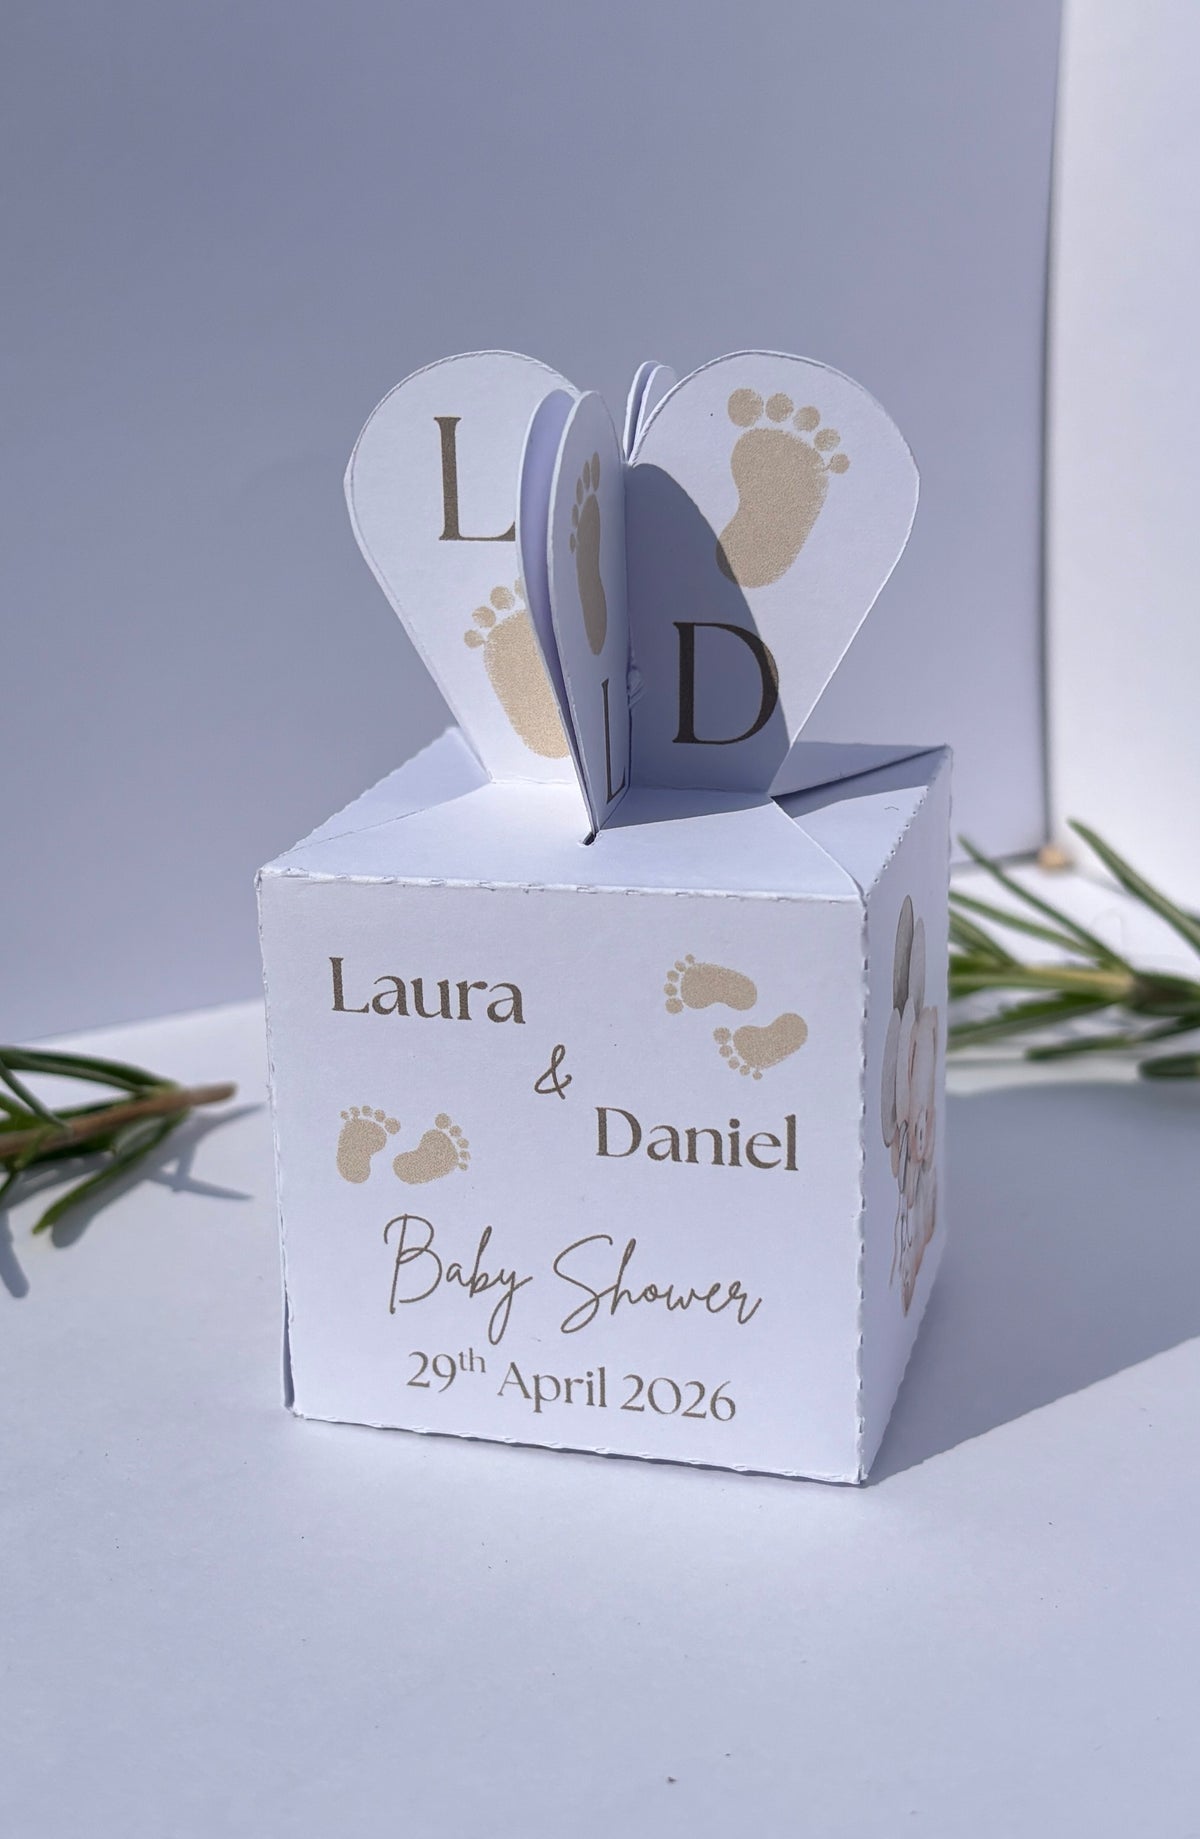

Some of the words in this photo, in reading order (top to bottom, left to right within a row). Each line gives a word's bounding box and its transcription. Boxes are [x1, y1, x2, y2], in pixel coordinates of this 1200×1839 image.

[433, 416, 516, 542] L
[672, 621, 779, 745] D
[601, 677, 626, 805] L
[328, 956, 527, 1025] Laura
[533, 1043, 573, 1101] &
[594, 1106, 799, 1172] Daniel
[383, 1213, 534, 1346] Baby
[552, 1234, 763, 1335] Shower
[405, 1346, 487, 1393] 29th
[496, 1361, 608, 1414] April
[619, 1373, 737, 1422] 2026
